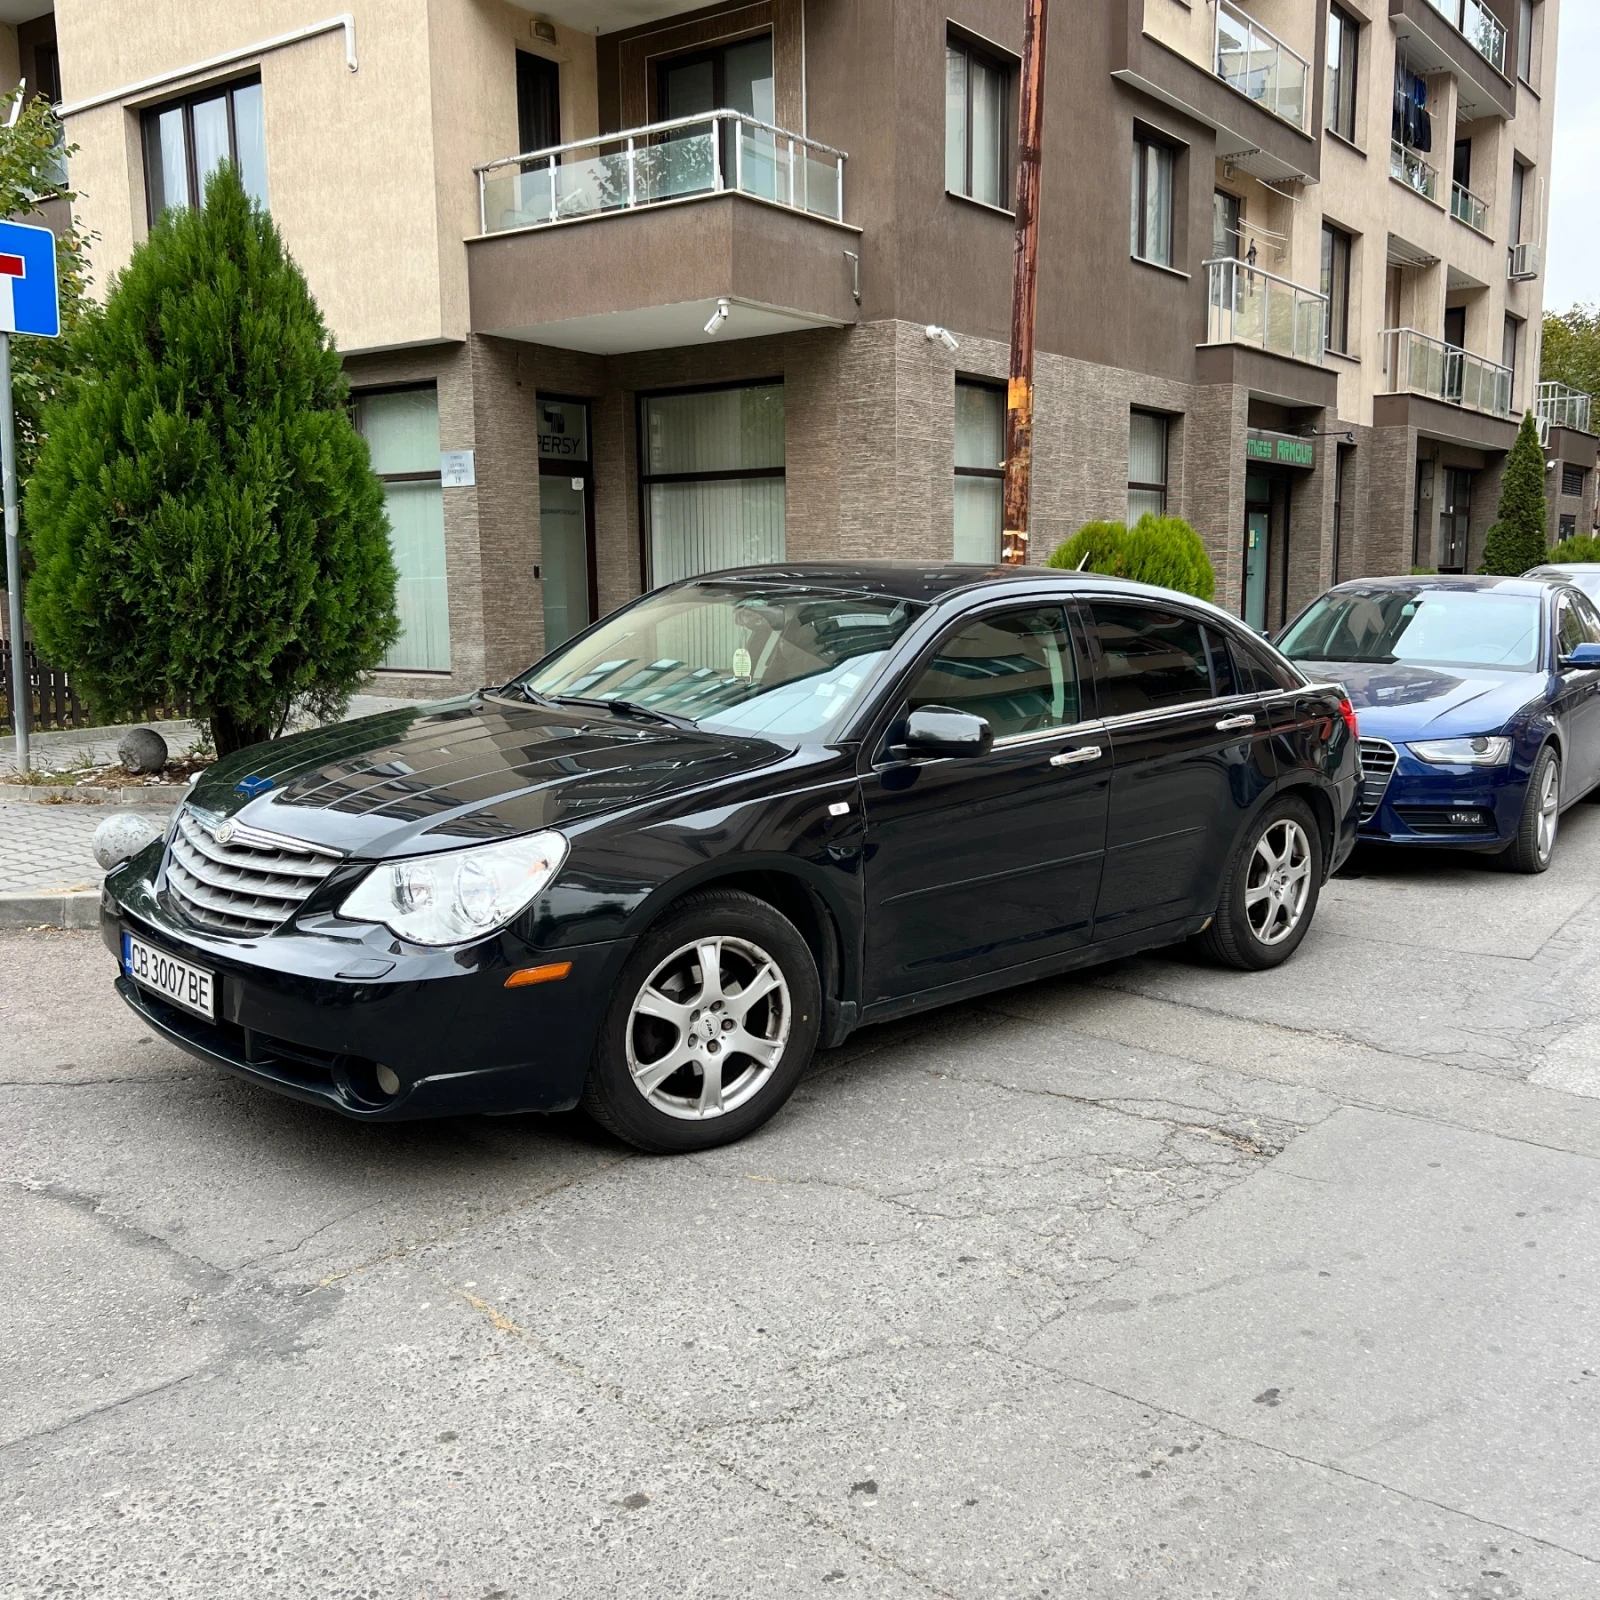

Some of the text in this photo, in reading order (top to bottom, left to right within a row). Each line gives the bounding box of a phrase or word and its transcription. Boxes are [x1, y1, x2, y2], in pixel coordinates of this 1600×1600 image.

[538, 434, 581, 454] PERSY
[1247, 439, 1313, 464] ITNESS ARMOUR
